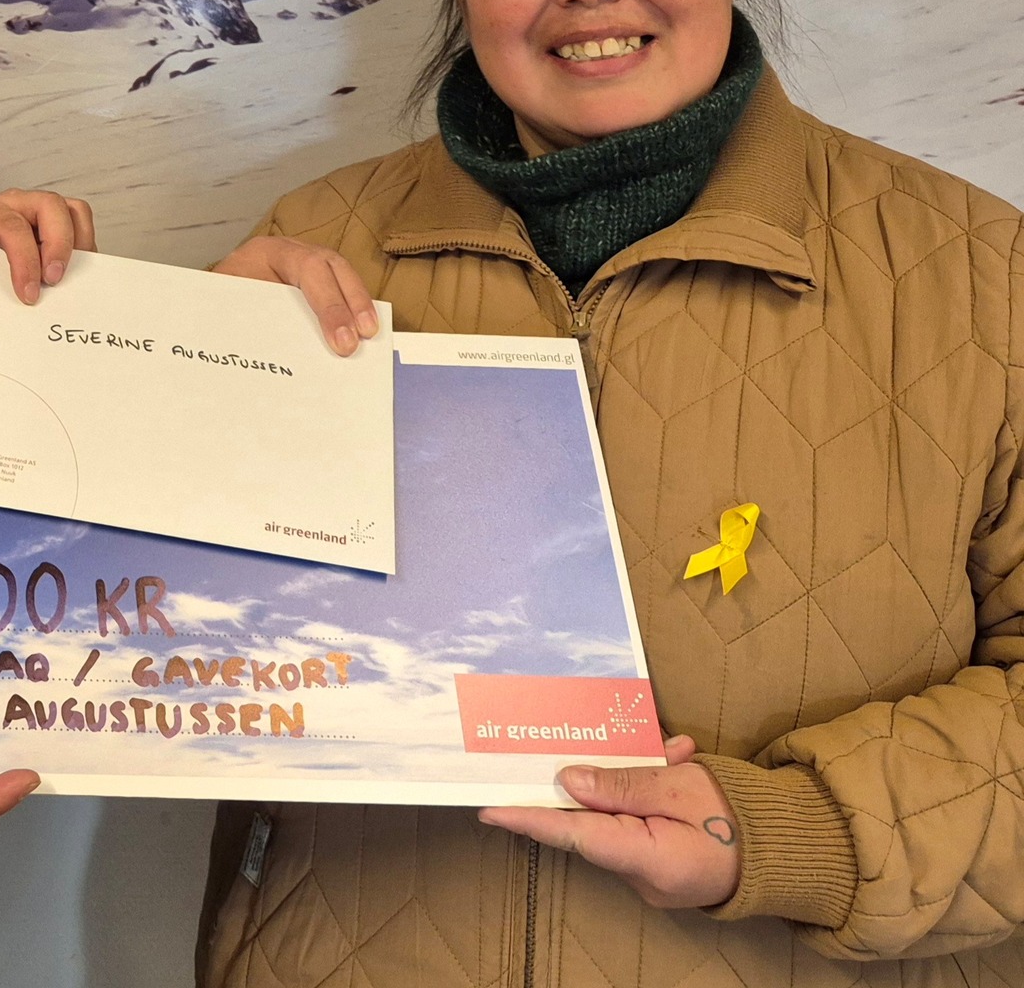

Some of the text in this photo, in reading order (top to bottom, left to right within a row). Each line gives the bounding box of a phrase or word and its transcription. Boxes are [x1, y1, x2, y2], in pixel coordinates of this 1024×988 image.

[48, 324, 293, 377] SEVERINE AUGUSTUSSEN
[457, 350, 576, 365] www.airgreenland.gl
[264, 521, 347, 545] air greenland
[95, 575, 176, 638] KR
[131, 650, 353, 691] GAVEKORT
[3, 694, 305, 738] AUGUSTUSSEN
[477, 720, 609, 741] air greenland
